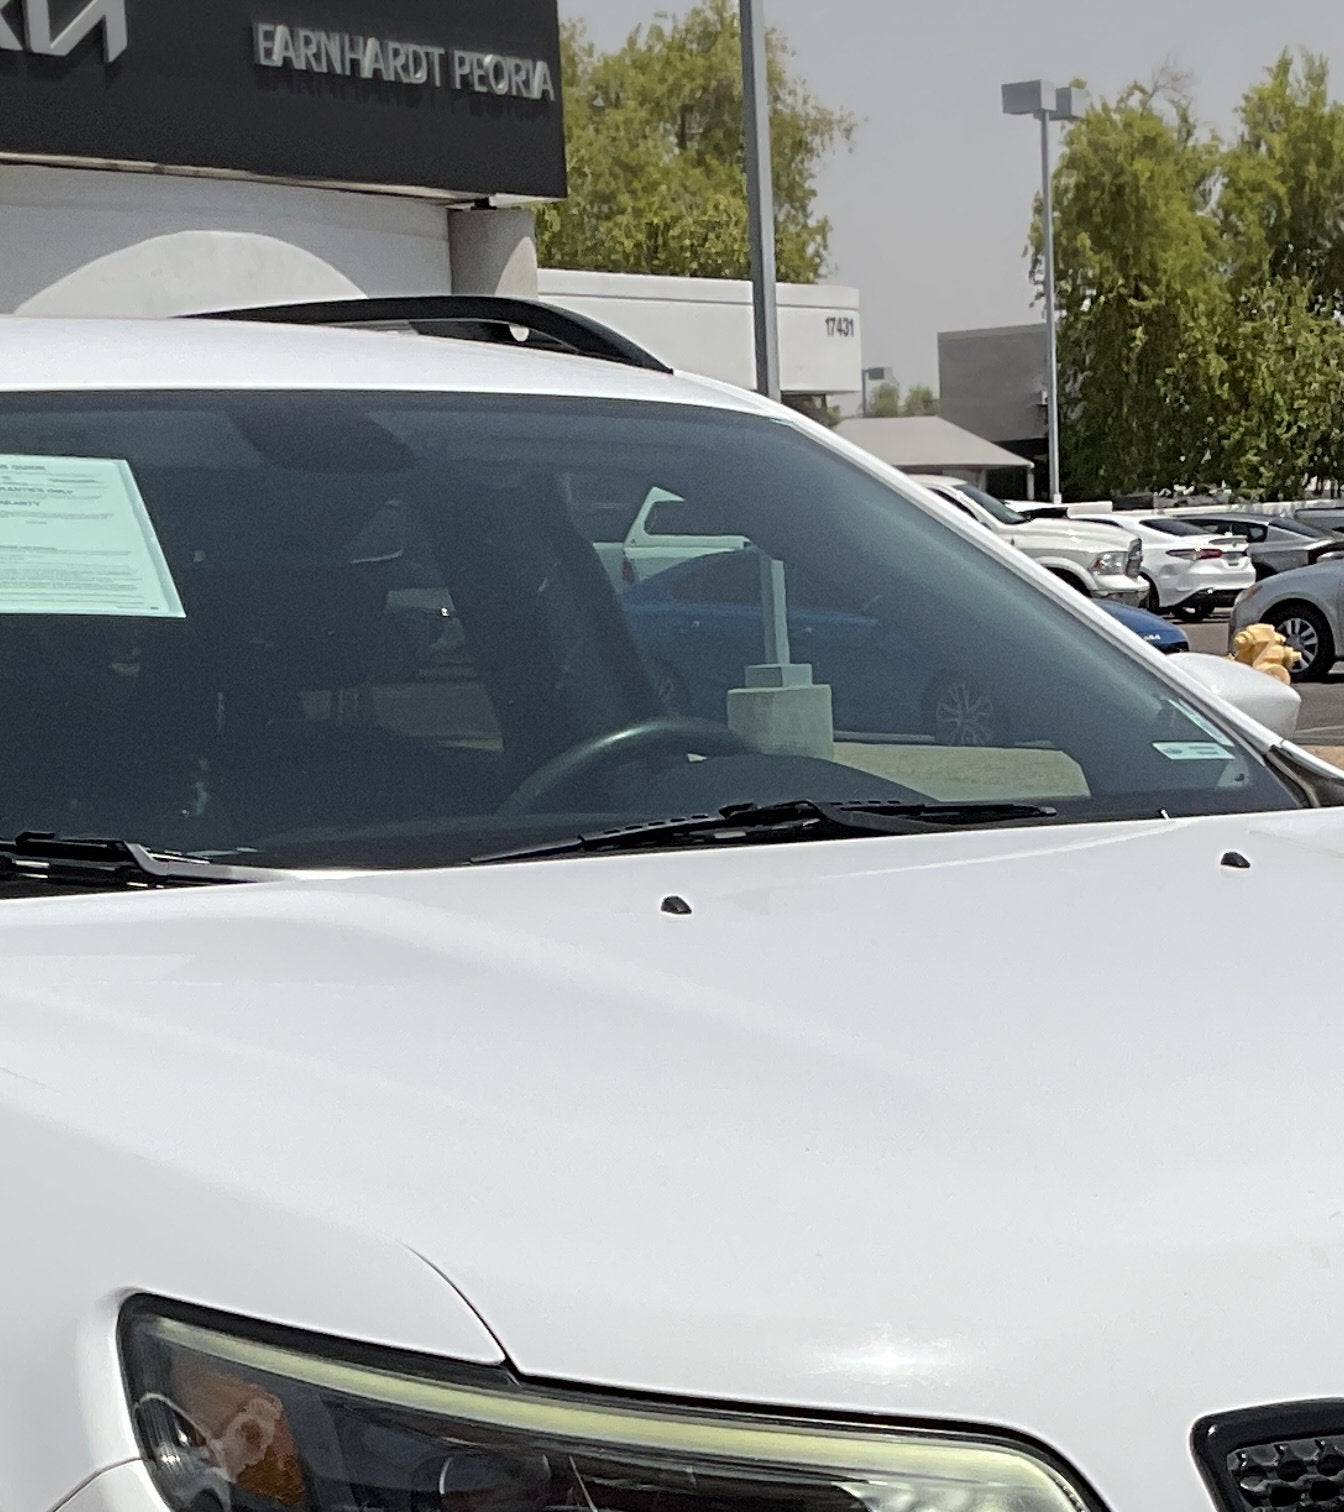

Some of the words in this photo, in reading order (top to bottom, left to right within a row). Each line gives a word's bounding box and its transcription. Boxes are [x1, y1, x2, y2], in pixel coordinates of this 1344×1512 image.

[254, 22, 445, 87] EARNHARDT
[452, 49, 555, 100] PEORIA
[824, 316, 855, 337] 17431
